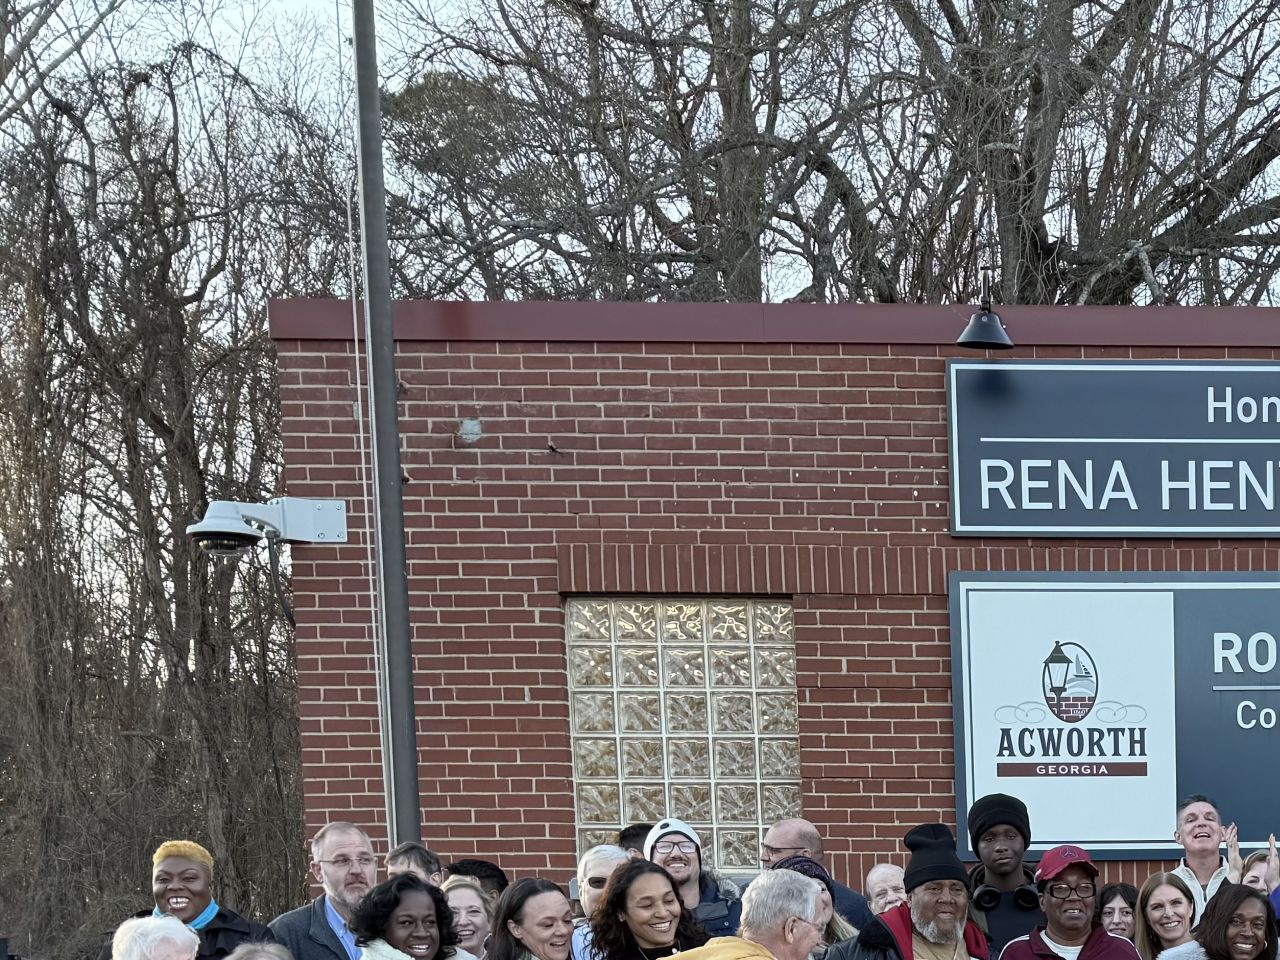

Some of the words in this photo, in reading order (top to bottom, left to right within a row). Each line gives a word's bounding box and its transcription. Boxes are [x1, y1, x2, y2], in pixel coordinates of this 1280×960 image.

[980, 459, 1139, 510] RENA
[996, 727, 1148, 758] ACWORTH
[1036, 765, 1109, 775] GEORGIA
